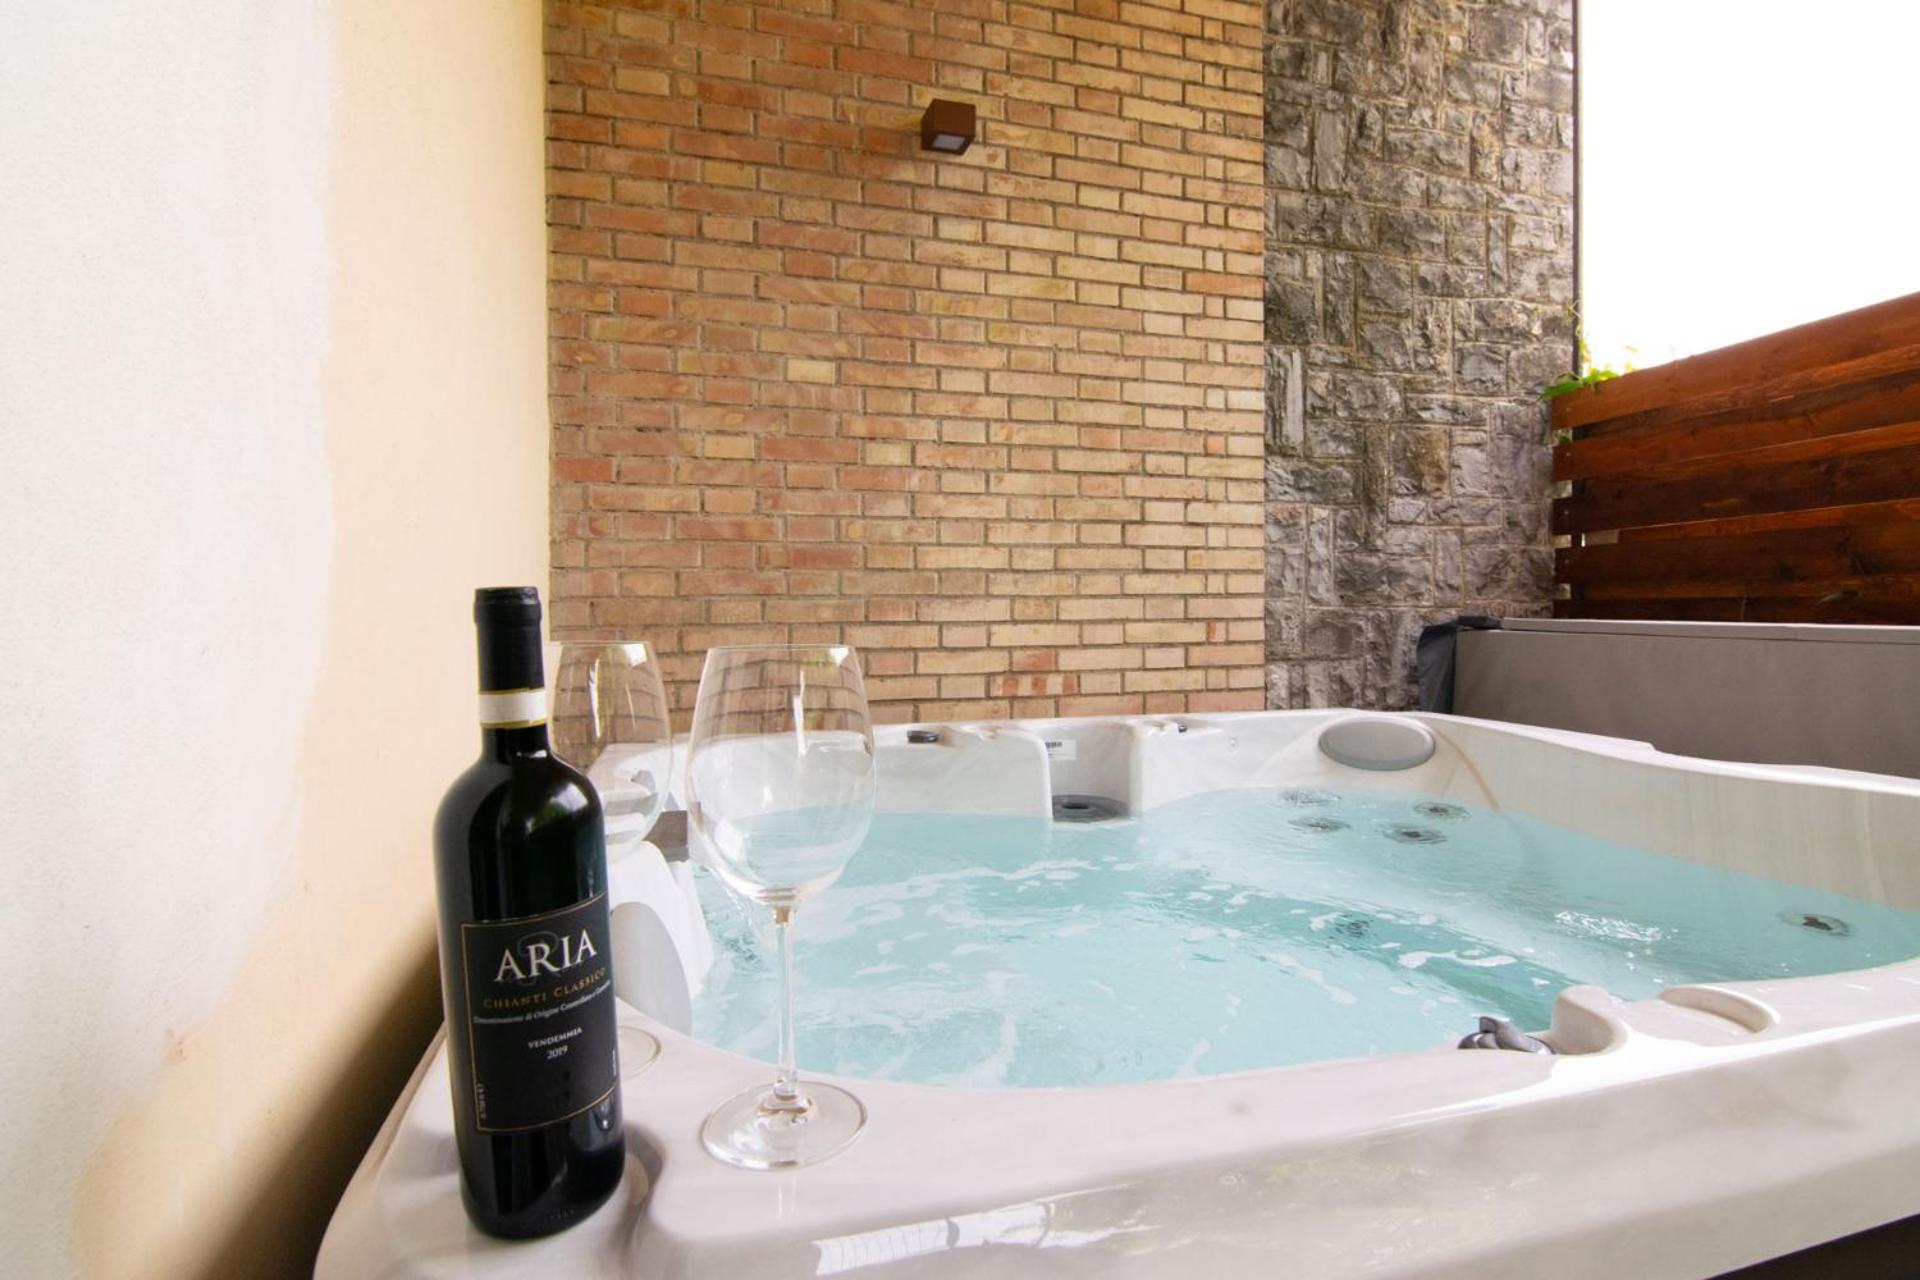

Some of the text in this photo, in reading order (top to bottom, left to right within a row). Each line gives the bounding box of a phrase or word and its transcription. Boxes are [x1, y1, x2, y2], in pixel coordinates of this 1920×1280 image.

[494, 928, 597, 982] ARIA
[483, 993, 546, 1008] CHIANTI
[528, 1026, 583, 1049] VENDEMMIA
